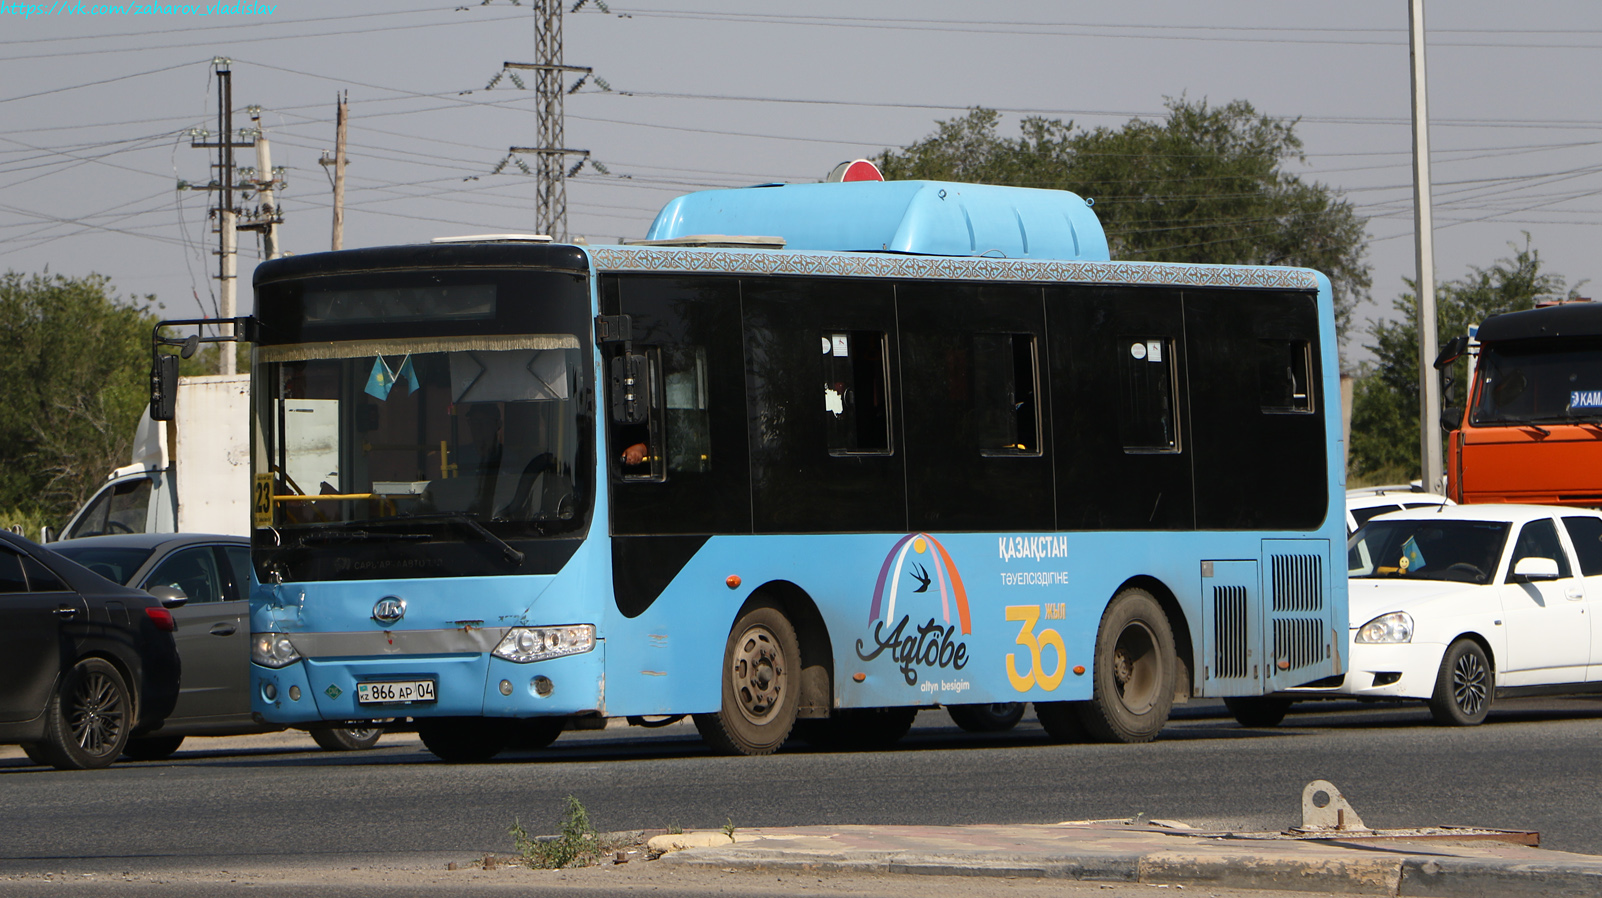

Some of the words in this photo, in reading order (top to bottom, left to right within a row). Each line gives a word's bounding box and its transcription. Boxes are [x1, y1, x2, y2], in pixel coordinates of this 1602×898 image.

[1580, 392, 1602, 406] КАМ
[255, 482, 270, 513] 23
[999, 536, 1068, 562] ҚАЗАҚСТАН
[1000, 571, 1069, 587] ТӘУЕЛСІЗДІГІНЕ
[1044, 603, 1066, 620] ЖЫЛ
[1005, 604, 1067, 693] 30
[371, 685, 396, 699] 866
[399, 687, 412, 699] AP
[417, 683, 433, 698] 04
[920, 680, 939, 694] altyn
[941, 679, 970, 693] besigim
[360, 693, 369, 701] KZ
